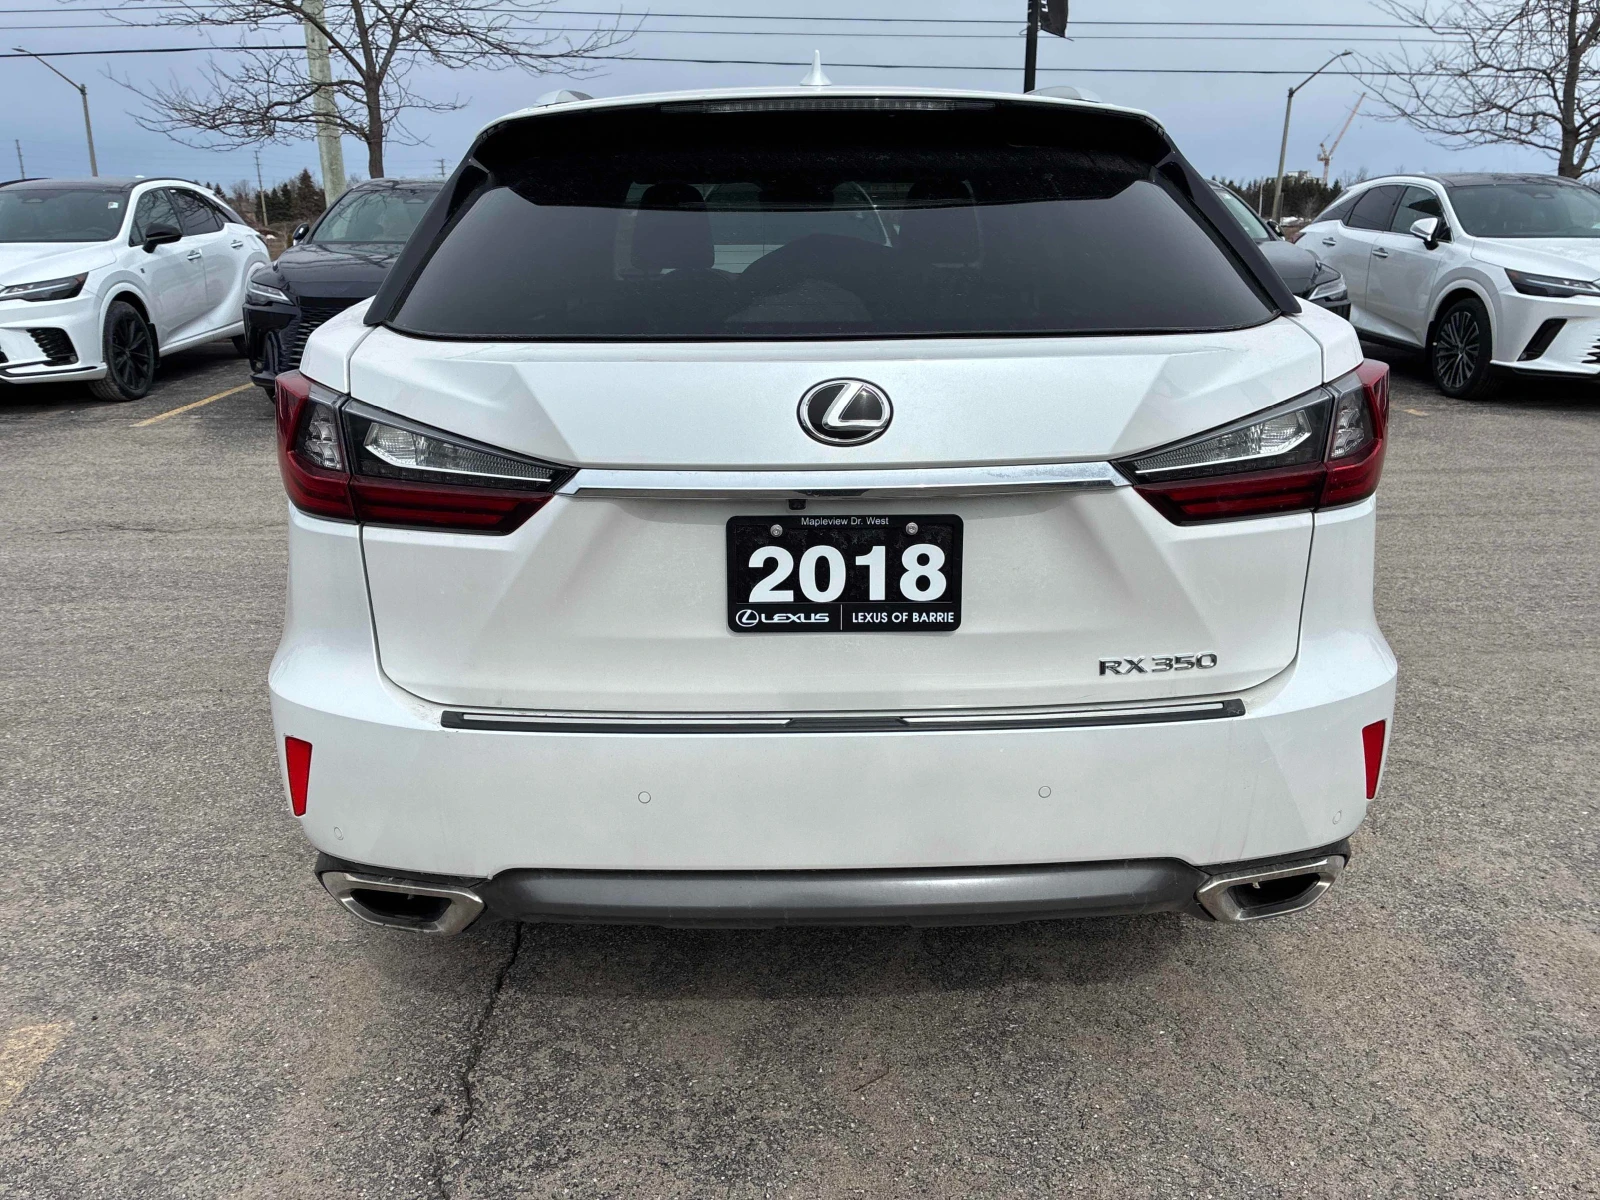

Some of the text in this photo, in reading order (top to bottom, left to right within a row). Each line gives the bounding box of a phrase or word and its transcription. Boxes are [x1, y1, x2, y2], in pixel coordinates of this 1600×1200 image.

[801, 516, 889, 526] Mapleview Dr. West
[748, 543, 947, 603] 2018
[761, 613, 829, 623] LEXUS
[852, 612, 955, 623] LEXUS OF BARRIE
